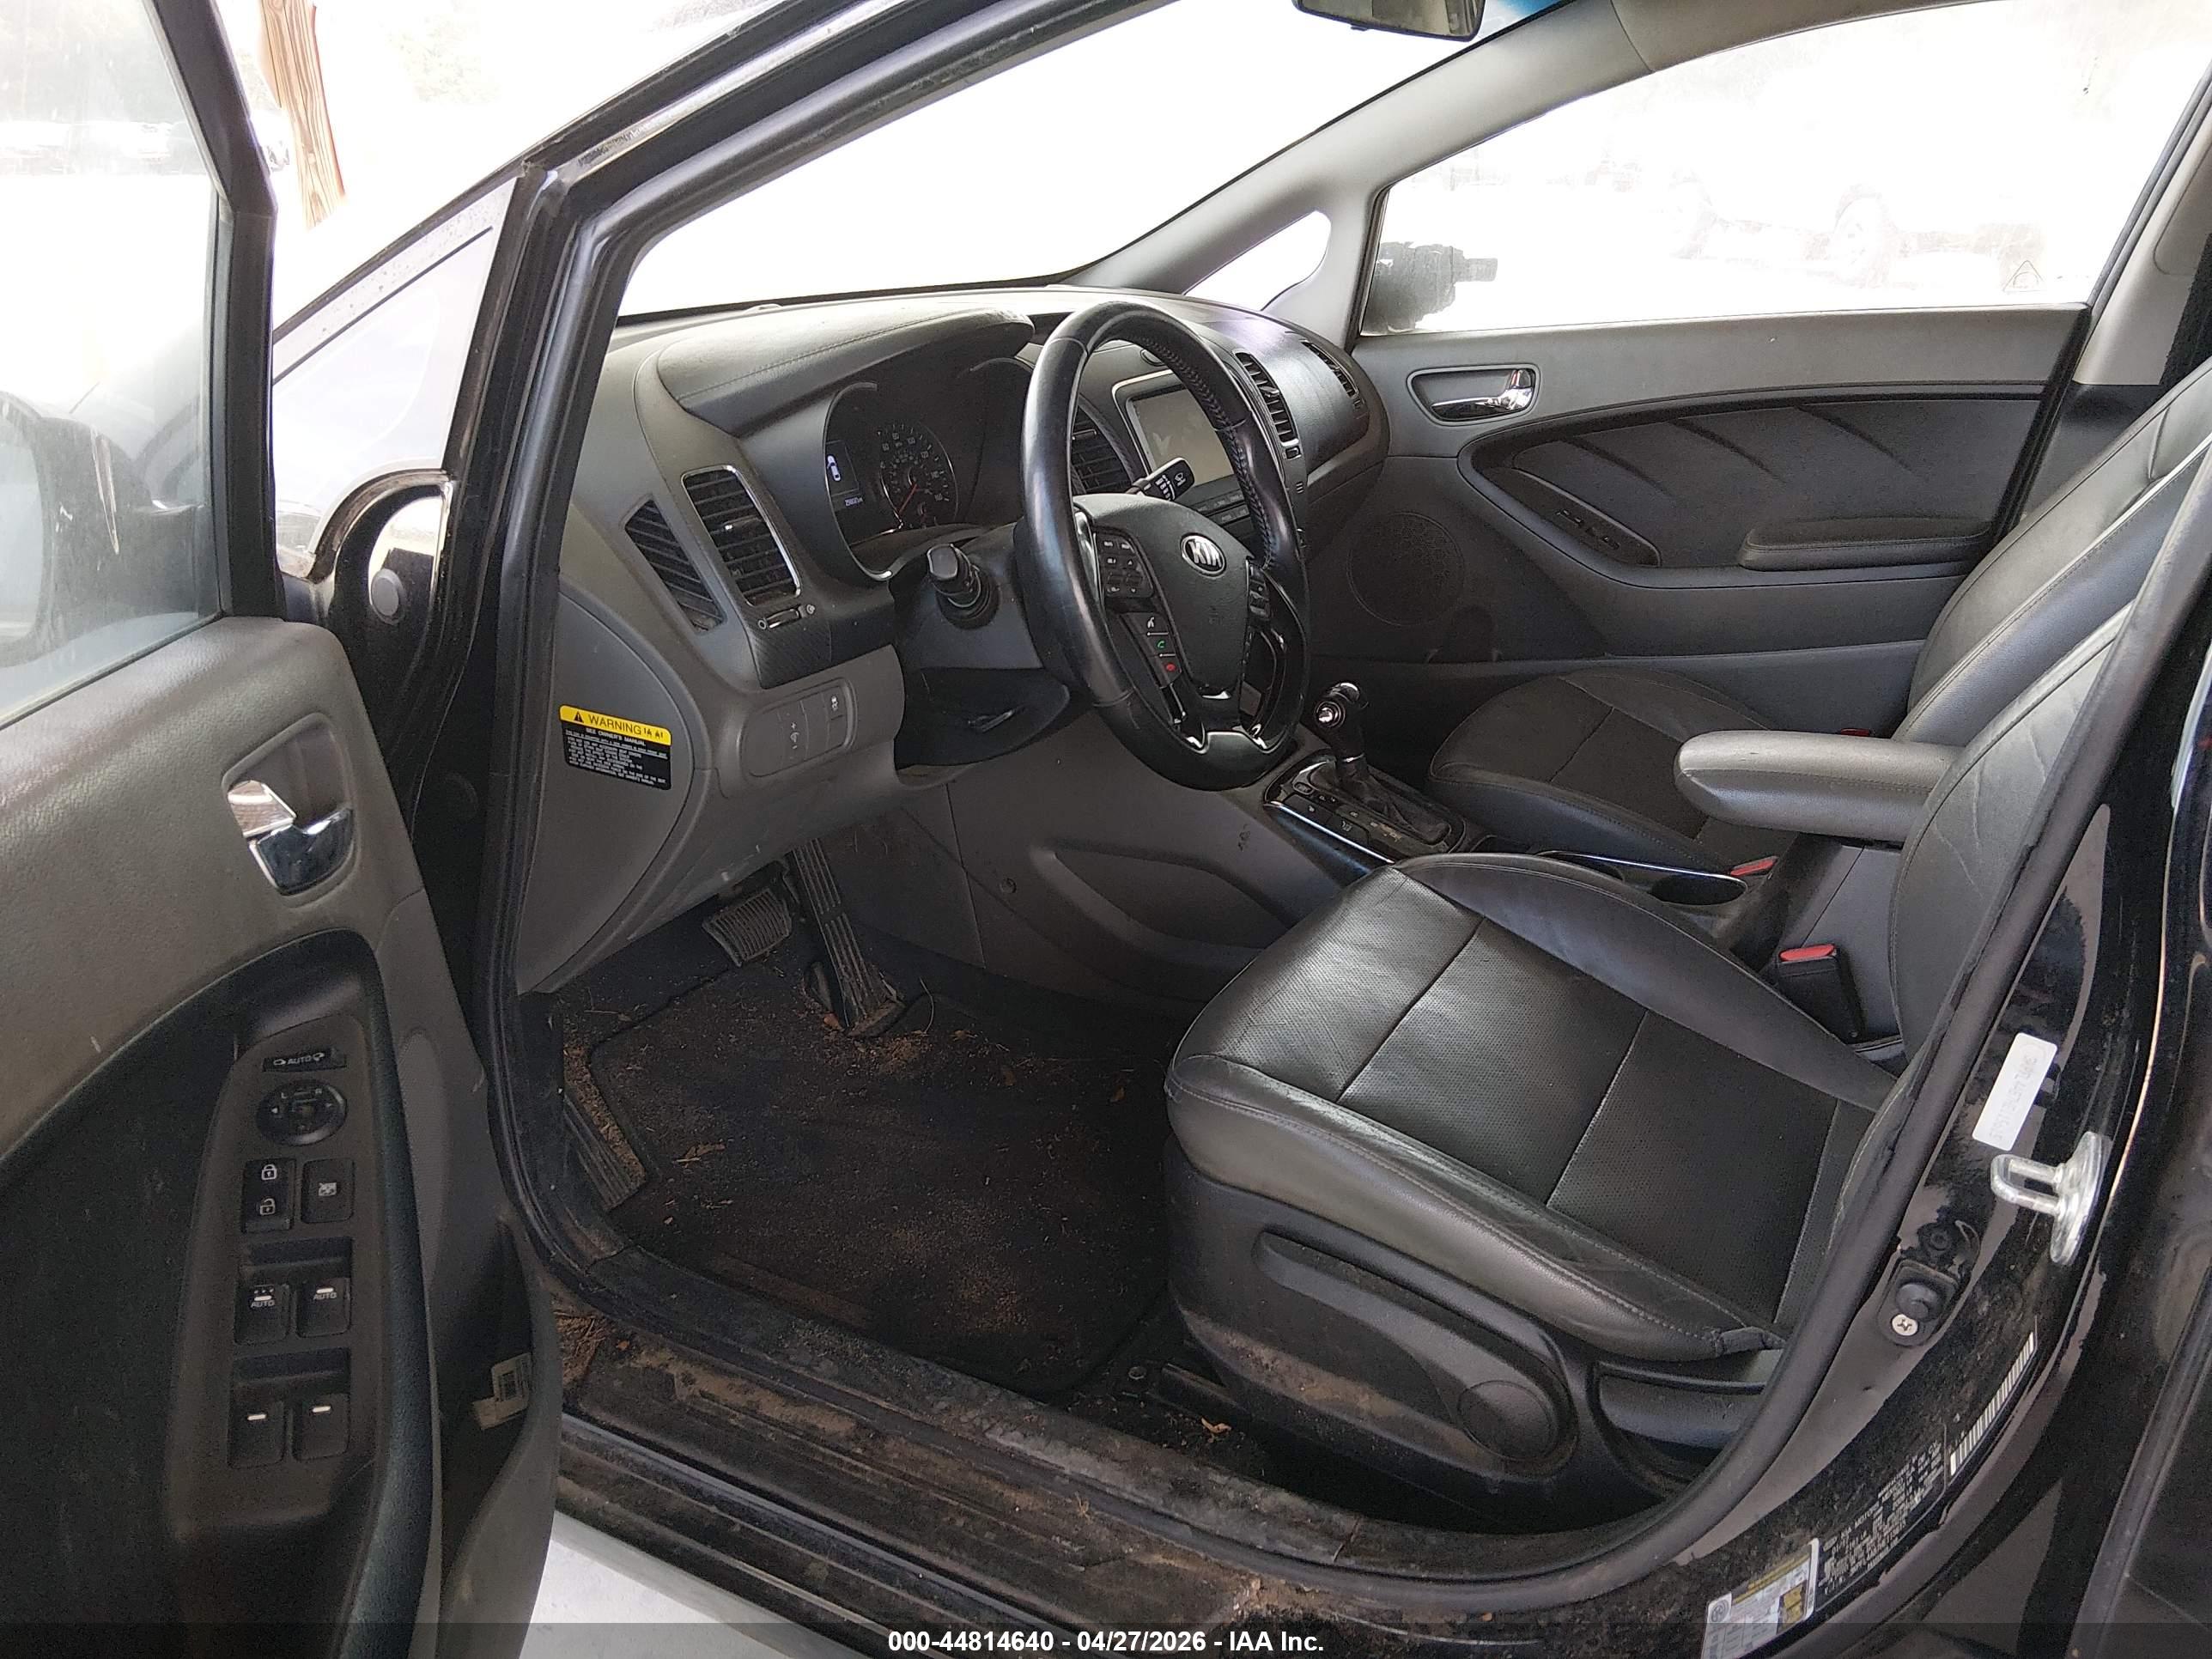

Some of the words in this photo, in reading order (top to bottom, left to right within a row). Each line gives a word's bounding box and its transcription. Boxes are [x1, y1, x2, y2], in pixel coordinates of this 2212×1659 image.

[1188, 540, 1222, 568] KIA
[587, 714, 642, 736] WARNING
[288, 1055, 313, 1065] AUTO
[313, 1291, 337, 1301] AUTO
[250, 1299, 275, 1309] AUTO
